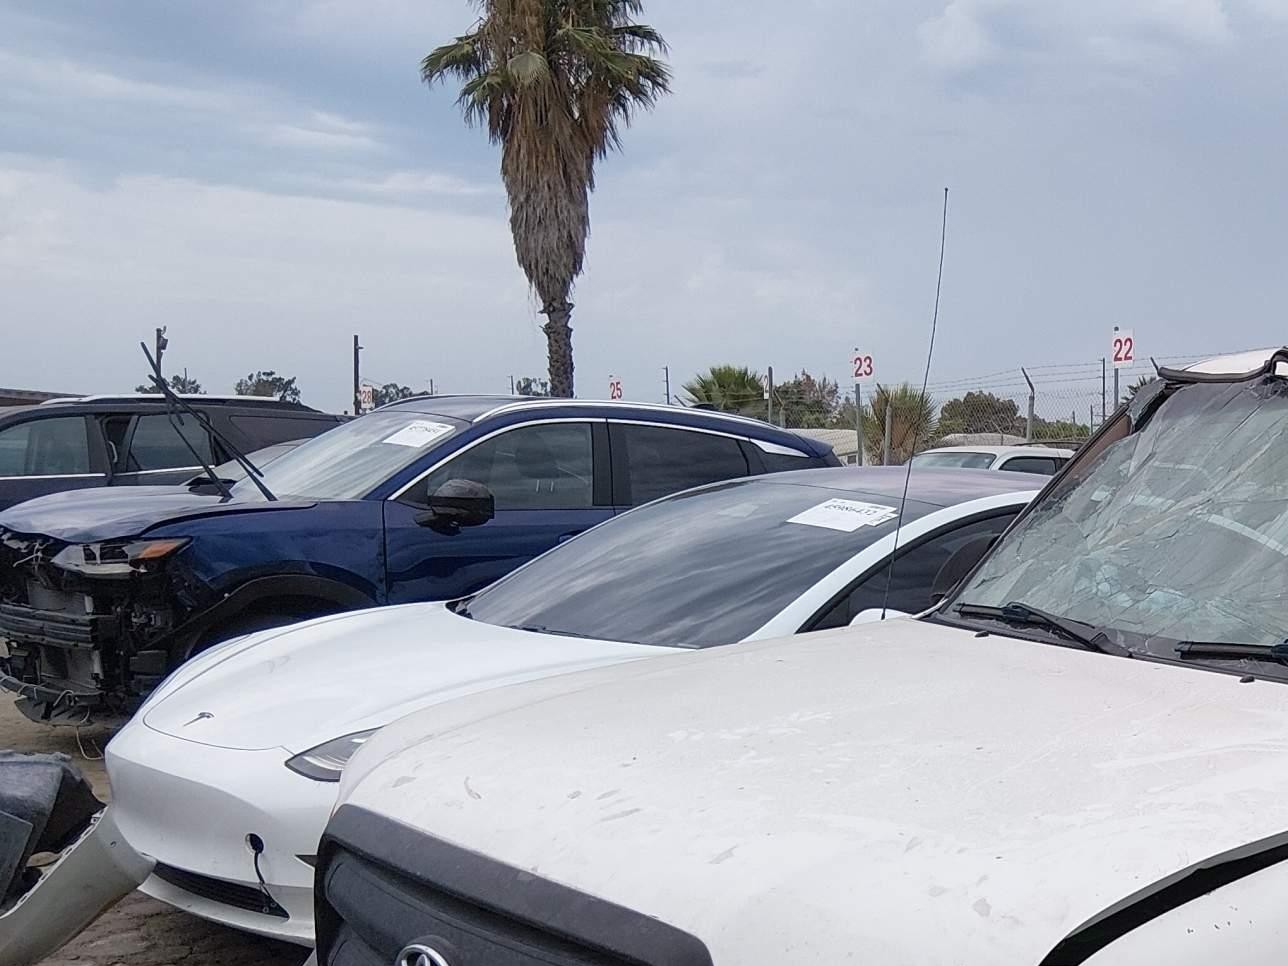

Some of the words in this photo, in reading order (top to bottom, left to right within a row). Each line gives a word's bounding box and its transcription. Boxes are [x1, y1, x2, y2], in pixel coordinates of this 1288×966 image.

[1113, 337, 1132, 361] 22
[853, 355, 873, 377] 23
[609, 381, 623, 399] 25
